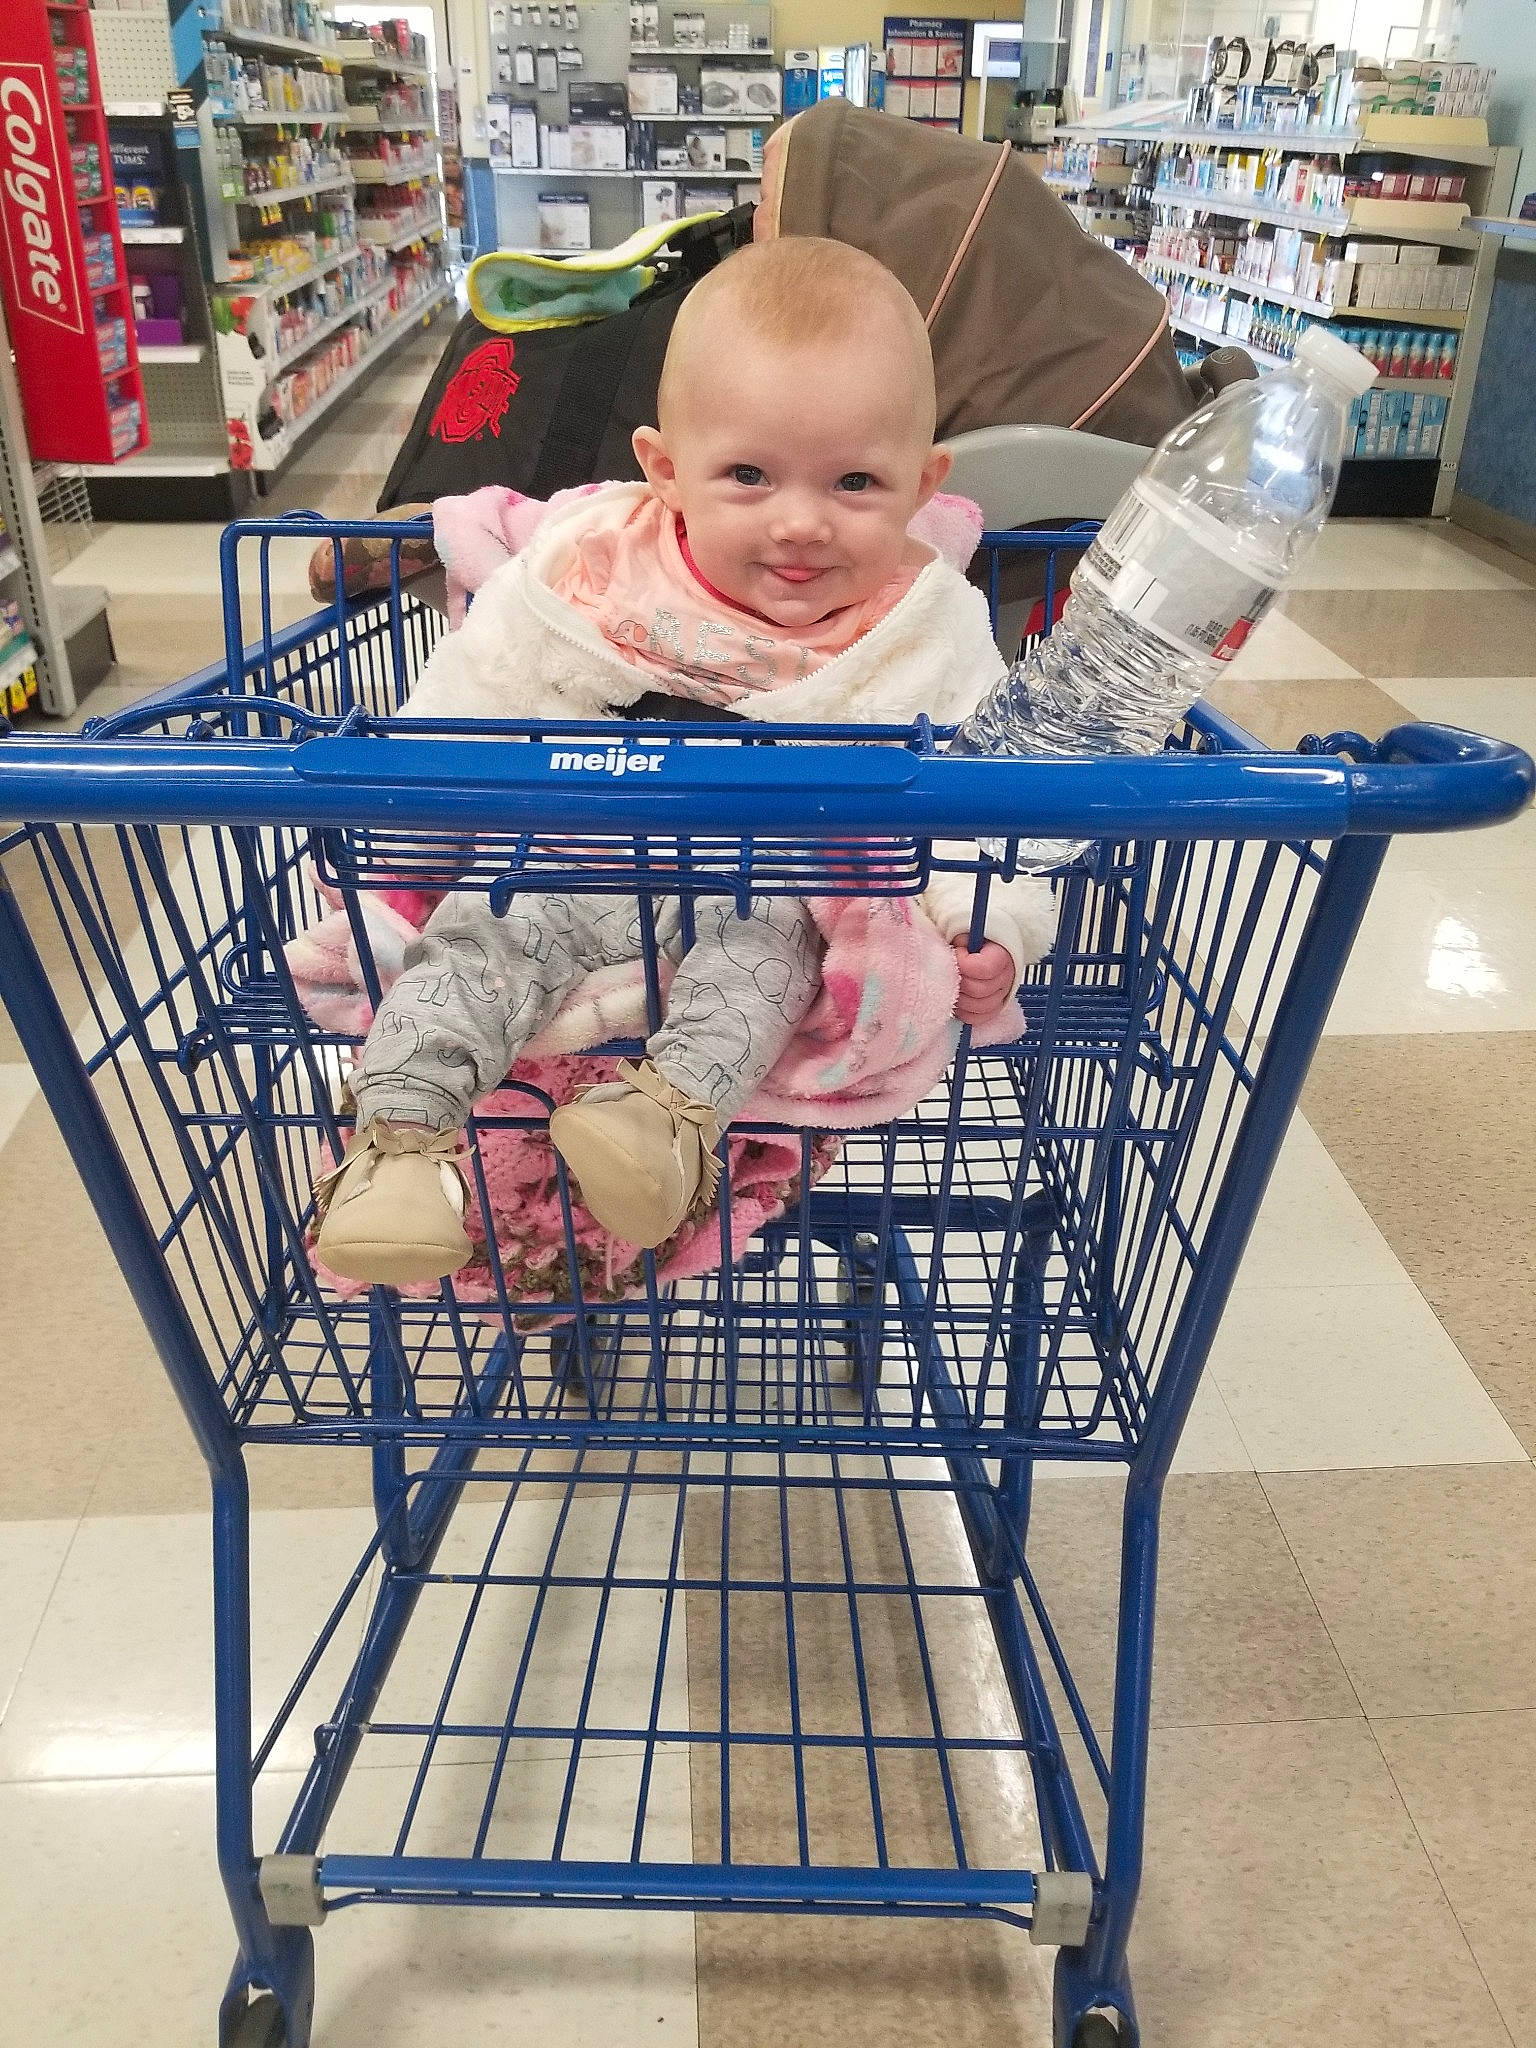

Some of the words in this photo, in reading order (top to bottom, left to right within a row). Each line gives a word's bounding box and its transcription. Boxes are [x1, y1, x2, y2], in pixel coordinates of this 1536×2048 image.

[887, 29, 927, 38] Information
[935, 30, 963, 39] Services
[909, 19, 943, 29] Pharmacy
[1, 77, 62, 305] Colgate
[549, 747, 665, 777] meijer
